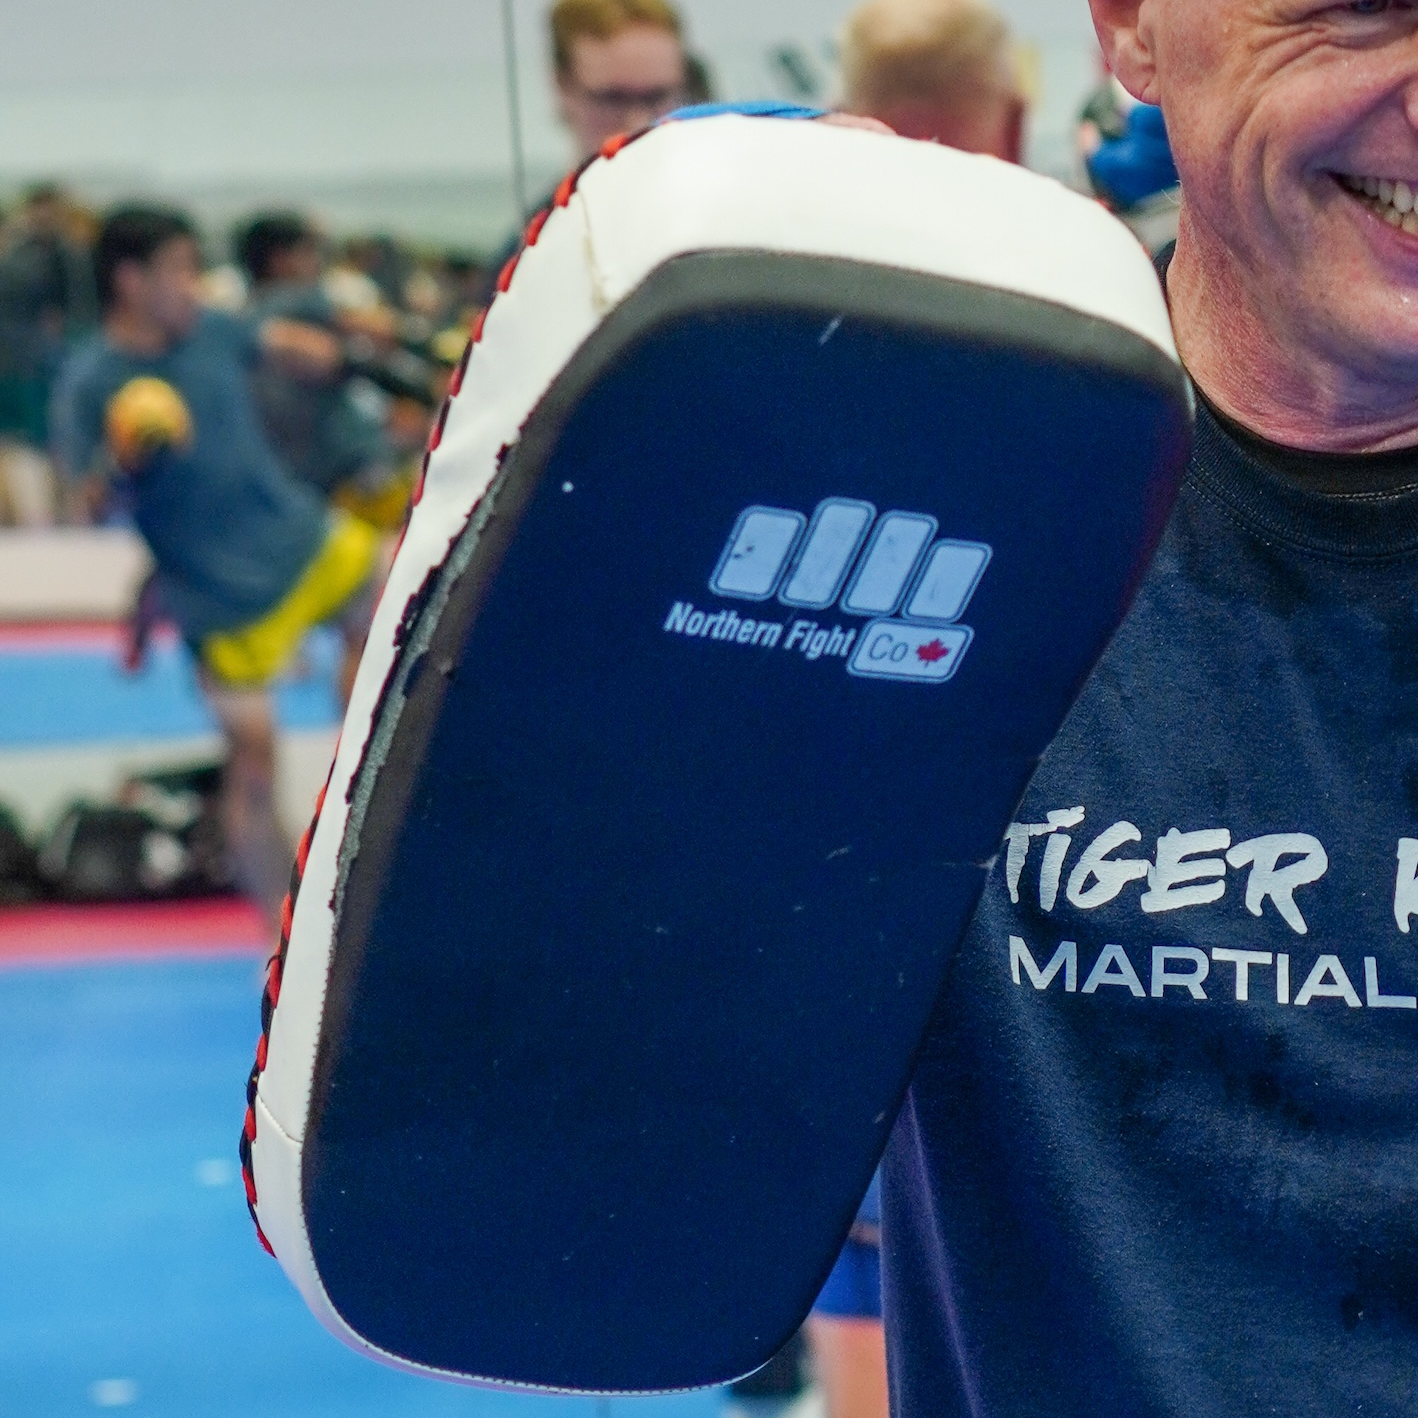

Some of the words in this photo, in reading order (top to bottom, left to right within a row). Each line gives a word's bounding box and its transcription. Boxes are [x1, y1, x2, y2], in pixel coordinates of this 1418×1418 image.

[664, 601, 785, 648] Northern
[784, 618, 857, 660] Fight
[868, 632, 909, 662] Co
[1008, 934, 1418, 1010] MARTIAL
